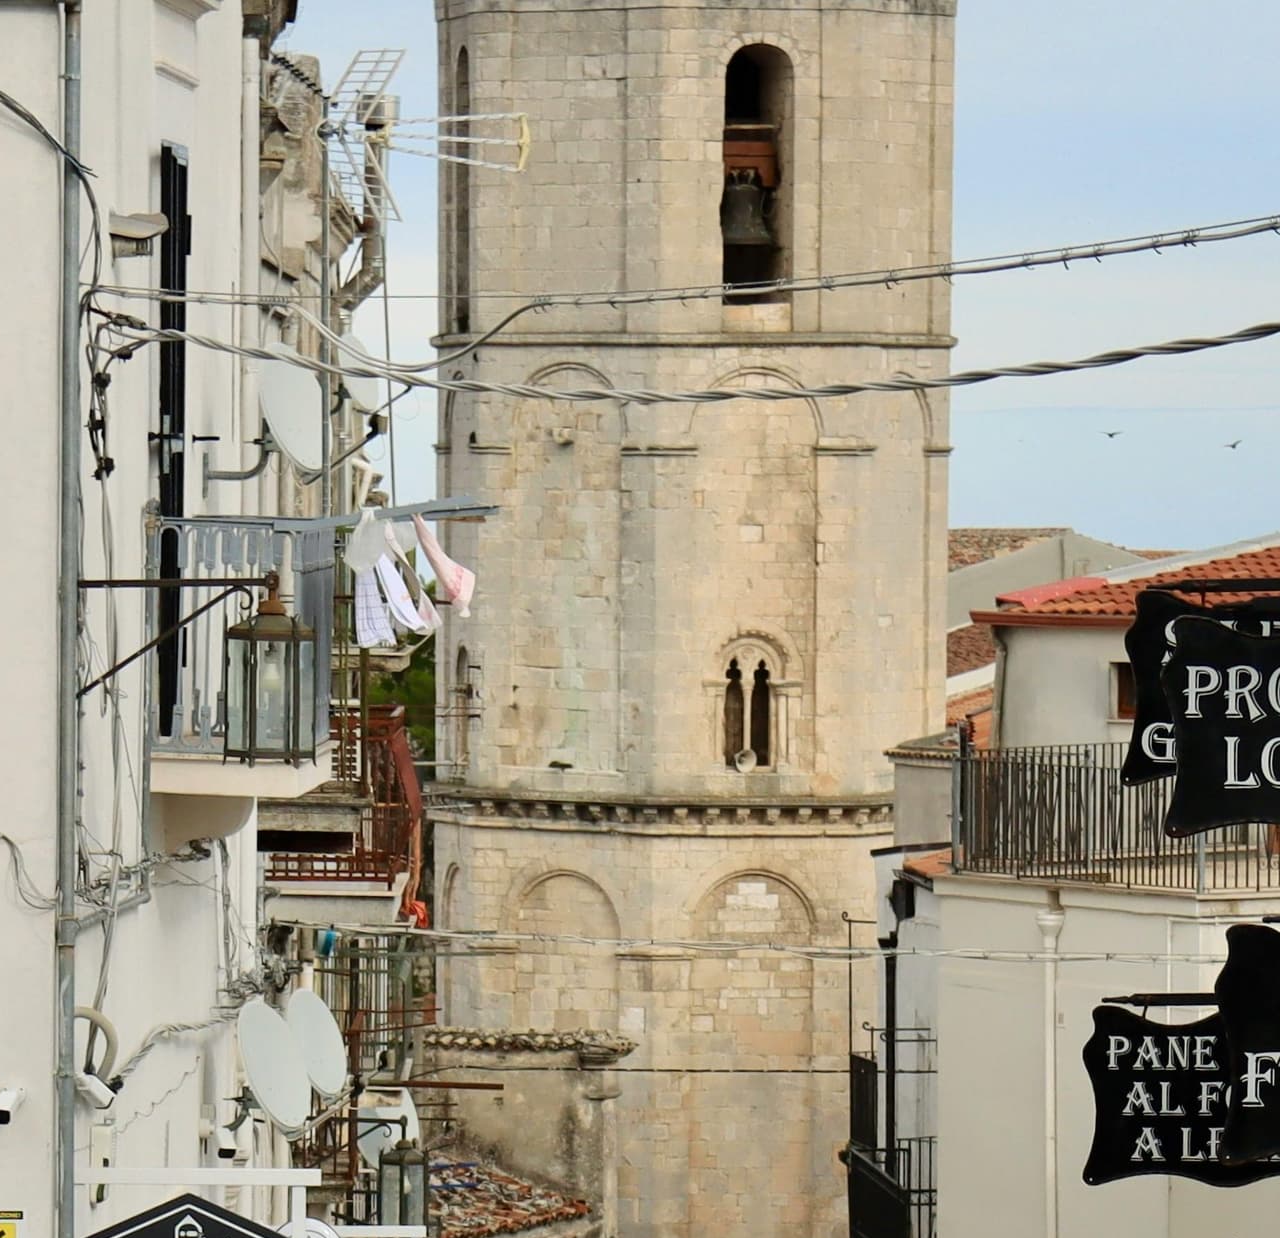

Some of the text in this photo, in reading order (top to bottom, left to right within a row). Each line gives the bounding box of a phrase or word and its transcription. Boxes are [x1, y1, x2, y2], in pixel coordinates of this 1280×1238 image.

[1106, 1035, 1218, 1071] PANE
[1122, 1081, 1185, 1116] AL
[1131, 1128, 1163, 1161] A
